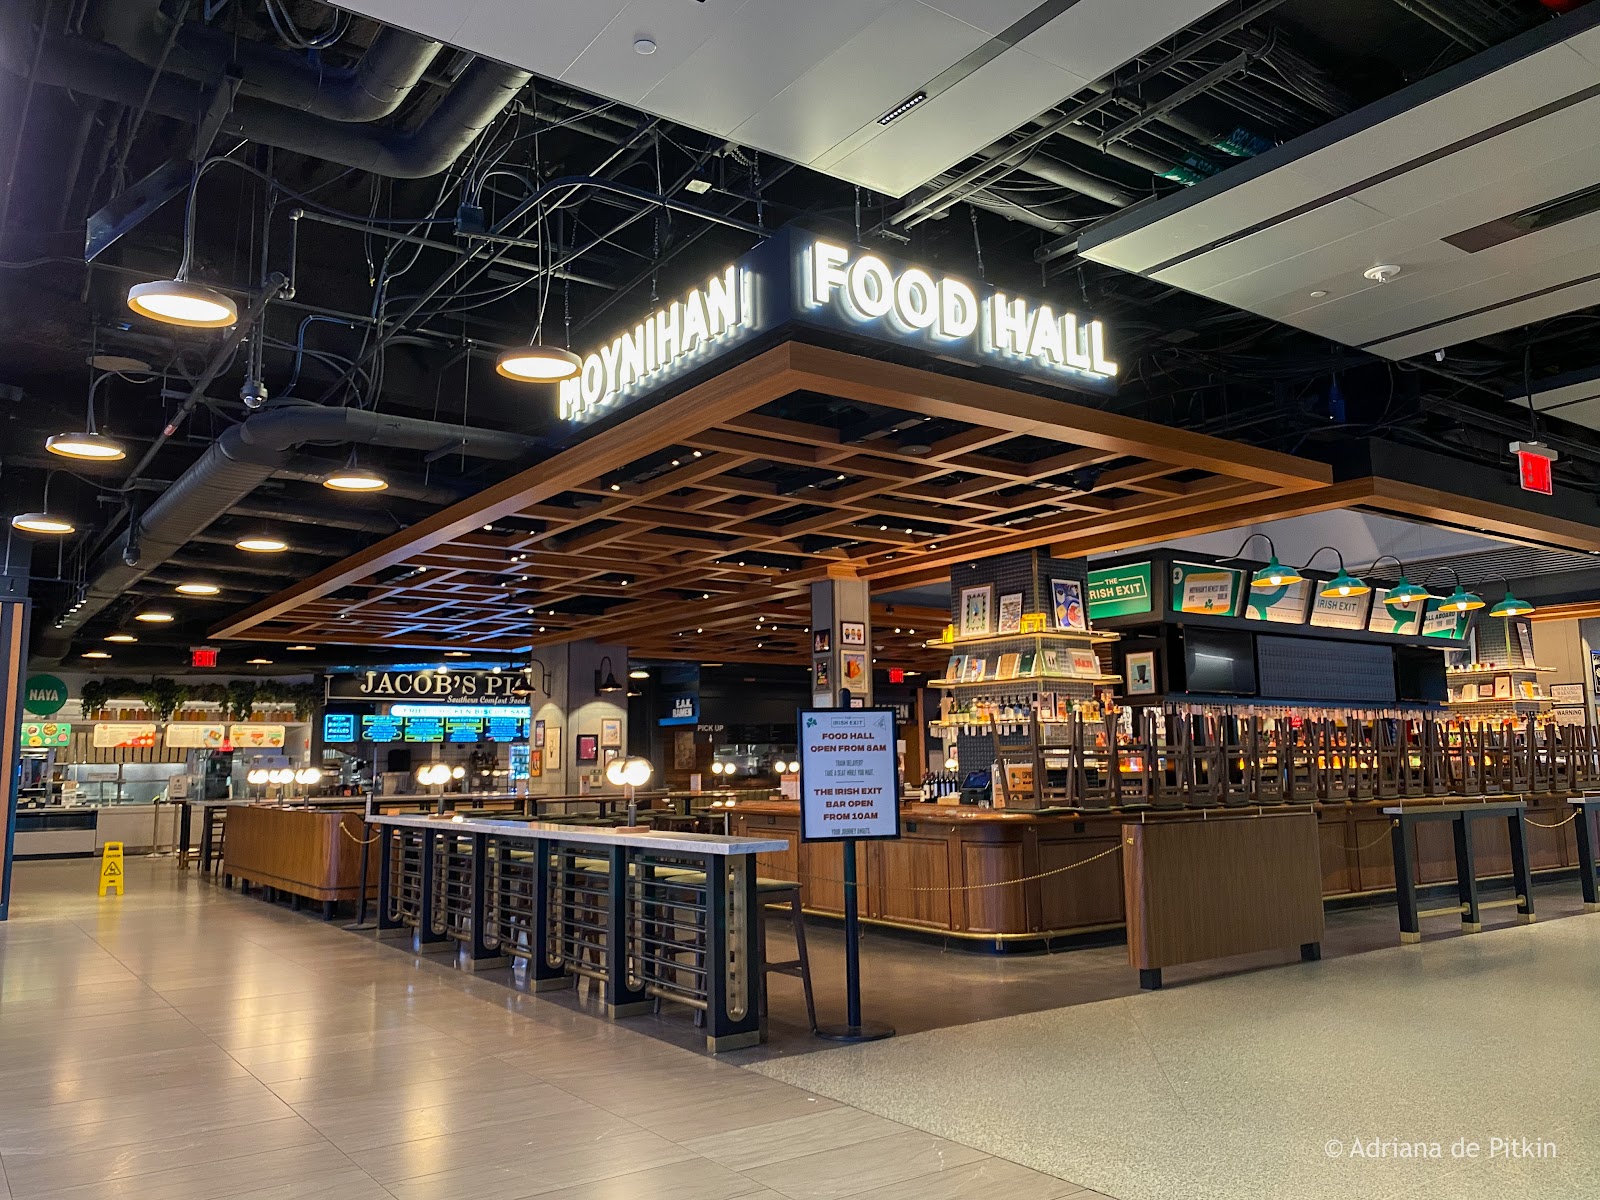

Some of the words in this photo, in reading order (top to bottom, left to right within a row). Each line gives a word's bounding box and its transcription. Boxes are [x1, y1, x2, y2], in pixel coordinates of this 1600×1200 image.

[811, 240, 978, 338] FOOD
[988, 291, 1117, 377] HALL
[558, 264, 746, 422] MOYNIHAN
[1104, 577, 1118, 585] THE
[1089, 587, 1115, 600] RISH
[1116, 583, 1141, 596] EXIT
[1317, 599, 1338, 610] IRISH
[1339, 601, 1357, 611] EXIT
[1435, 611, 1456, 620] ABOARD
[360, 671, 477, 695] JACOB'S
[29, 689, 59, 701] NAYA
[447, 695, 478, 704] Southern
[480, 696, 507, 705] Comfort
[508, 696, 527, 704] Food
[672, 708, 693, 718] RAMEN
[866, 744, 887, 752] 8AM
[861, 787, 883, 795] EXIT
